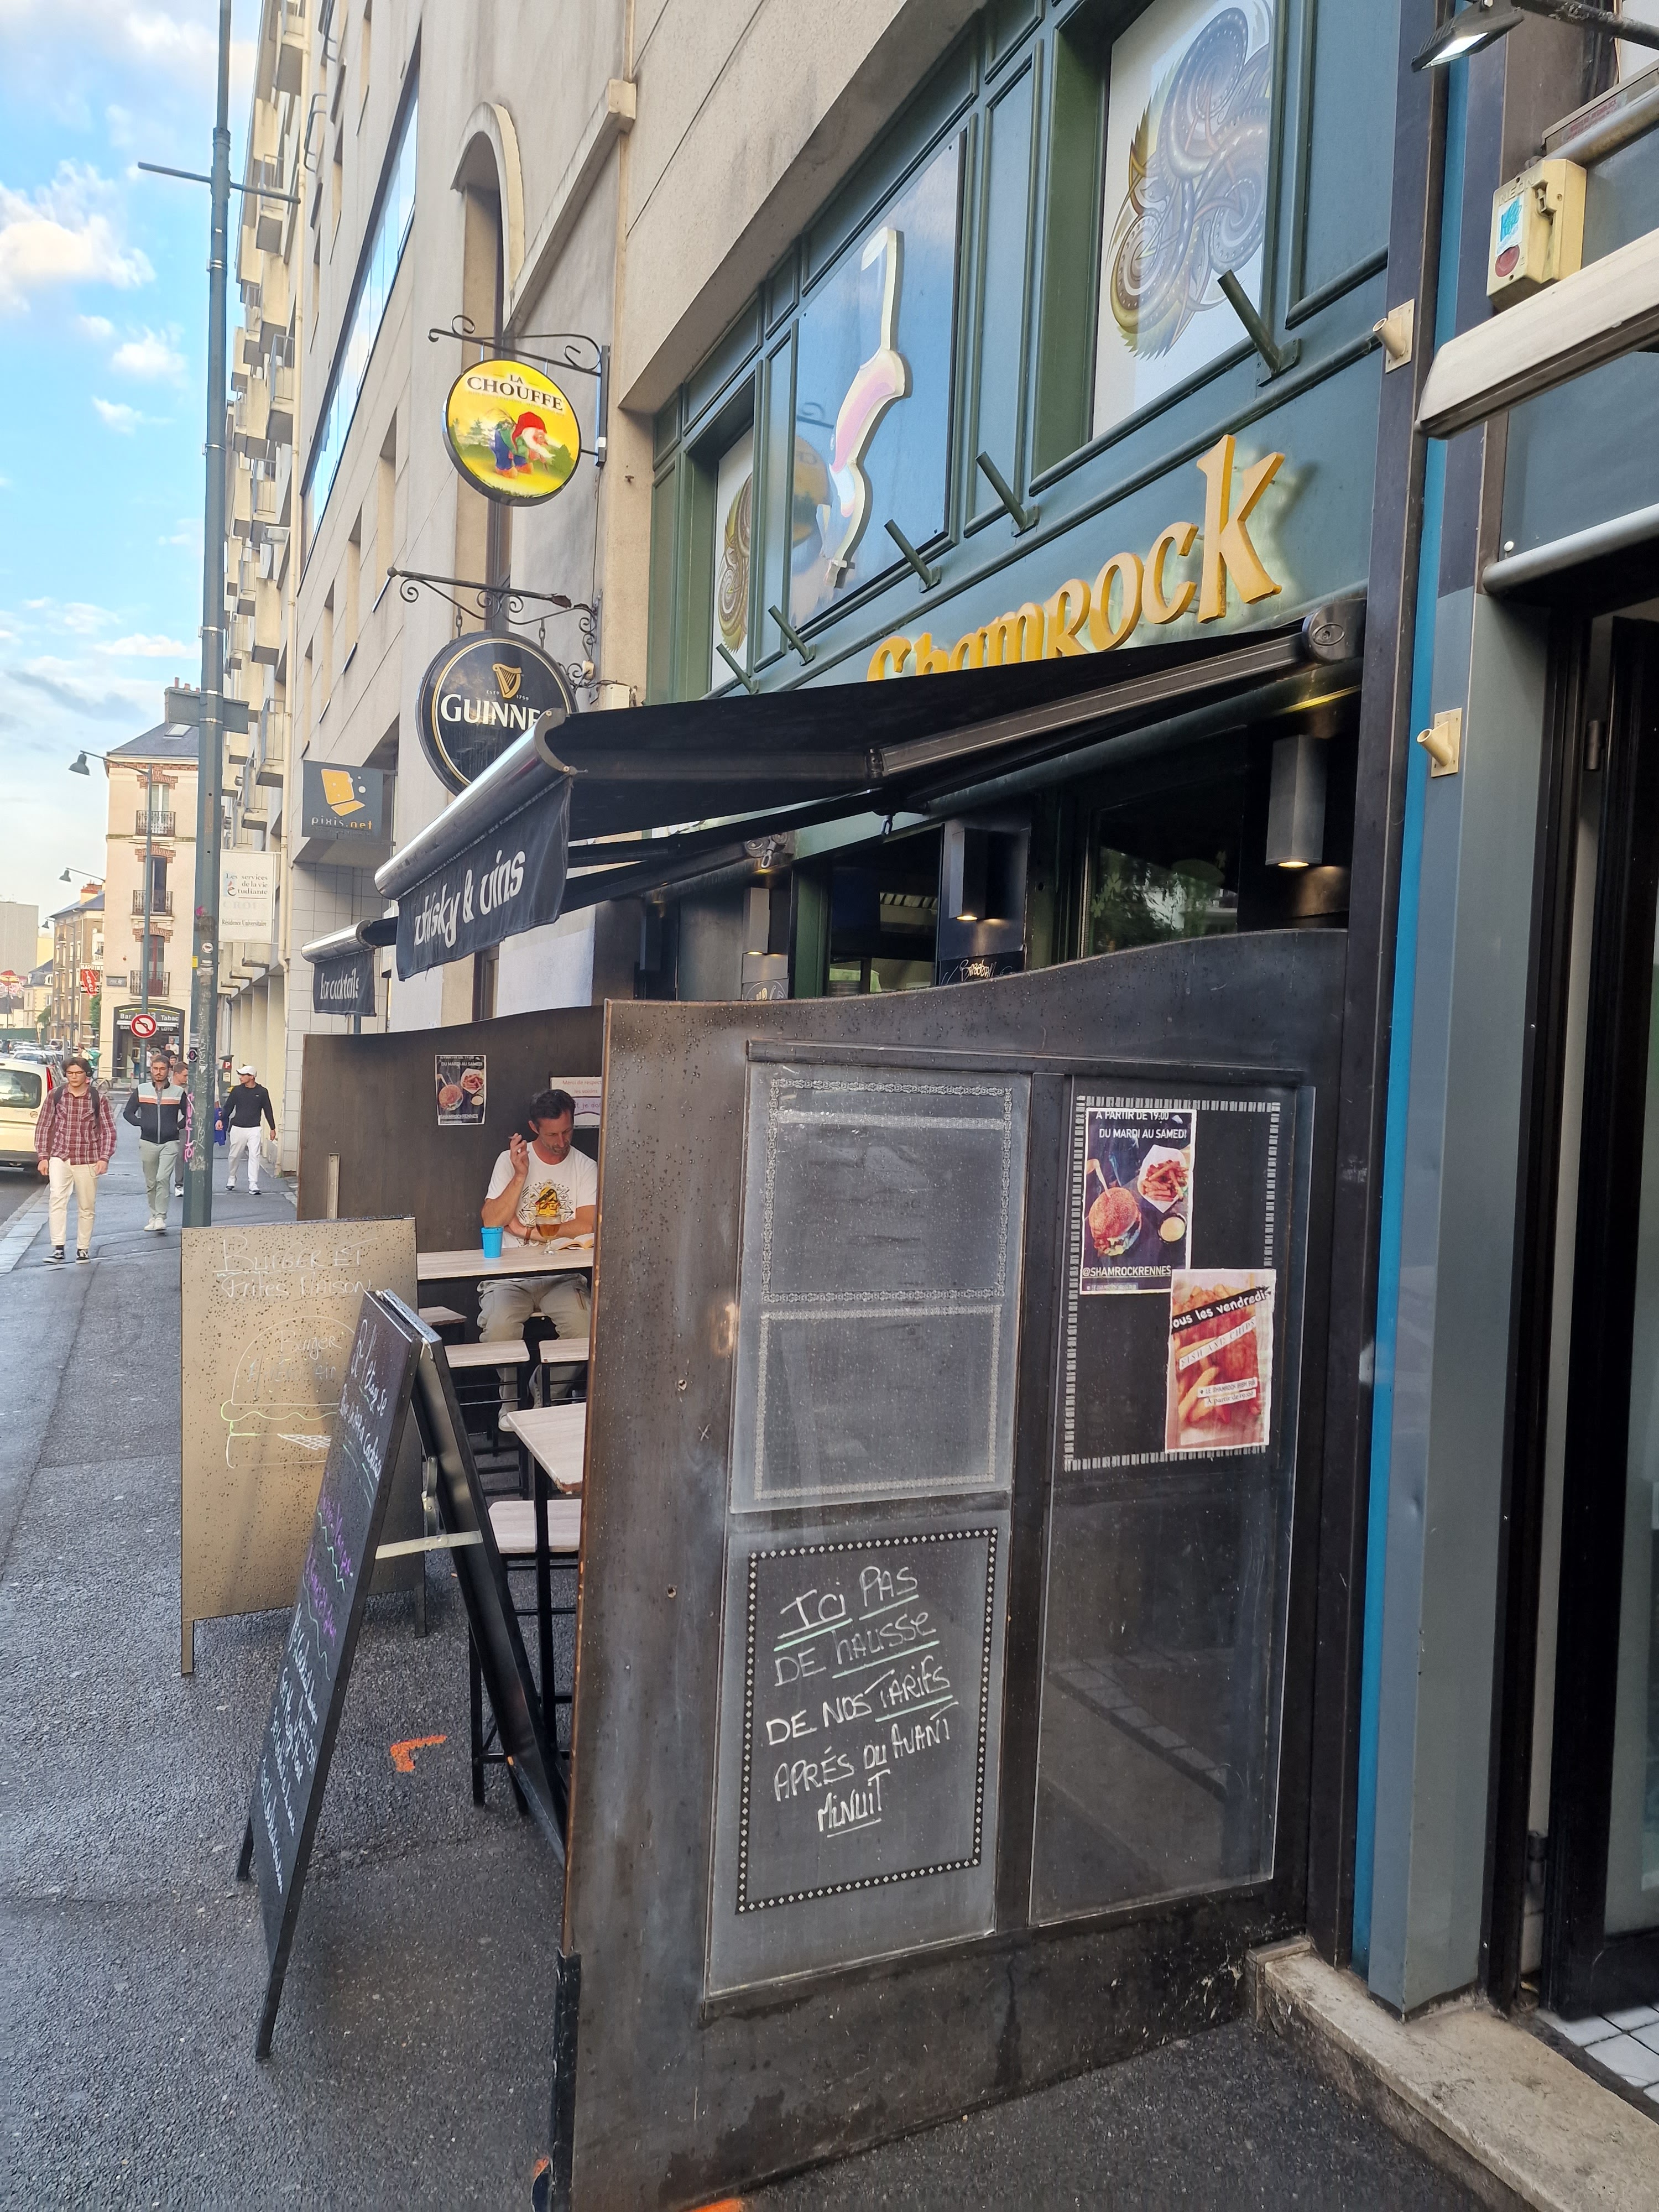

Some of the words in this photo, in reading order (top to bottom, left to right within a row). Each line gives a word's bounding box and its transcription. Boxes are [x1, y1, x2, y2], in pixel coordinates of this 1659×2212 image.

[467, 377, 563, 410] CHOUFFE
[510, 374, 523, 384] LA
[311, 815, 372, 830] pixis.net
[462, 869, 474, 924] &
[479, 850, 525, 915] vins
[1105, 1112, 1134, 1120] PARTIR
[1136, 1112, 1148, 1120] DE
[1150, 1112, 1169, 1120] 19:00
[1099, 1128, 1111, 1138] DU
[1113, 1129, 1140, 1138] MARDI
[1142, 1129, 1154, 1138] AU
[1156, 1129, 1187, 1139] SAMEDI
[1082, 1265, 1172, 1276] @SHAMROCKRENNES
[1195, 1308, 1213, 1321] les
[1215, 1289, 1271, 1314] vendredis
[859, 1566, 918, 1606] PAS
[774, 1647, 827, 1687] DE
[766, 1709, 817, 1745] DE
[822, 1693, 873, 1728] NOS
[863, 1744, 888, 1770] OU
[891, 1702, 959, 1759] AVANT
